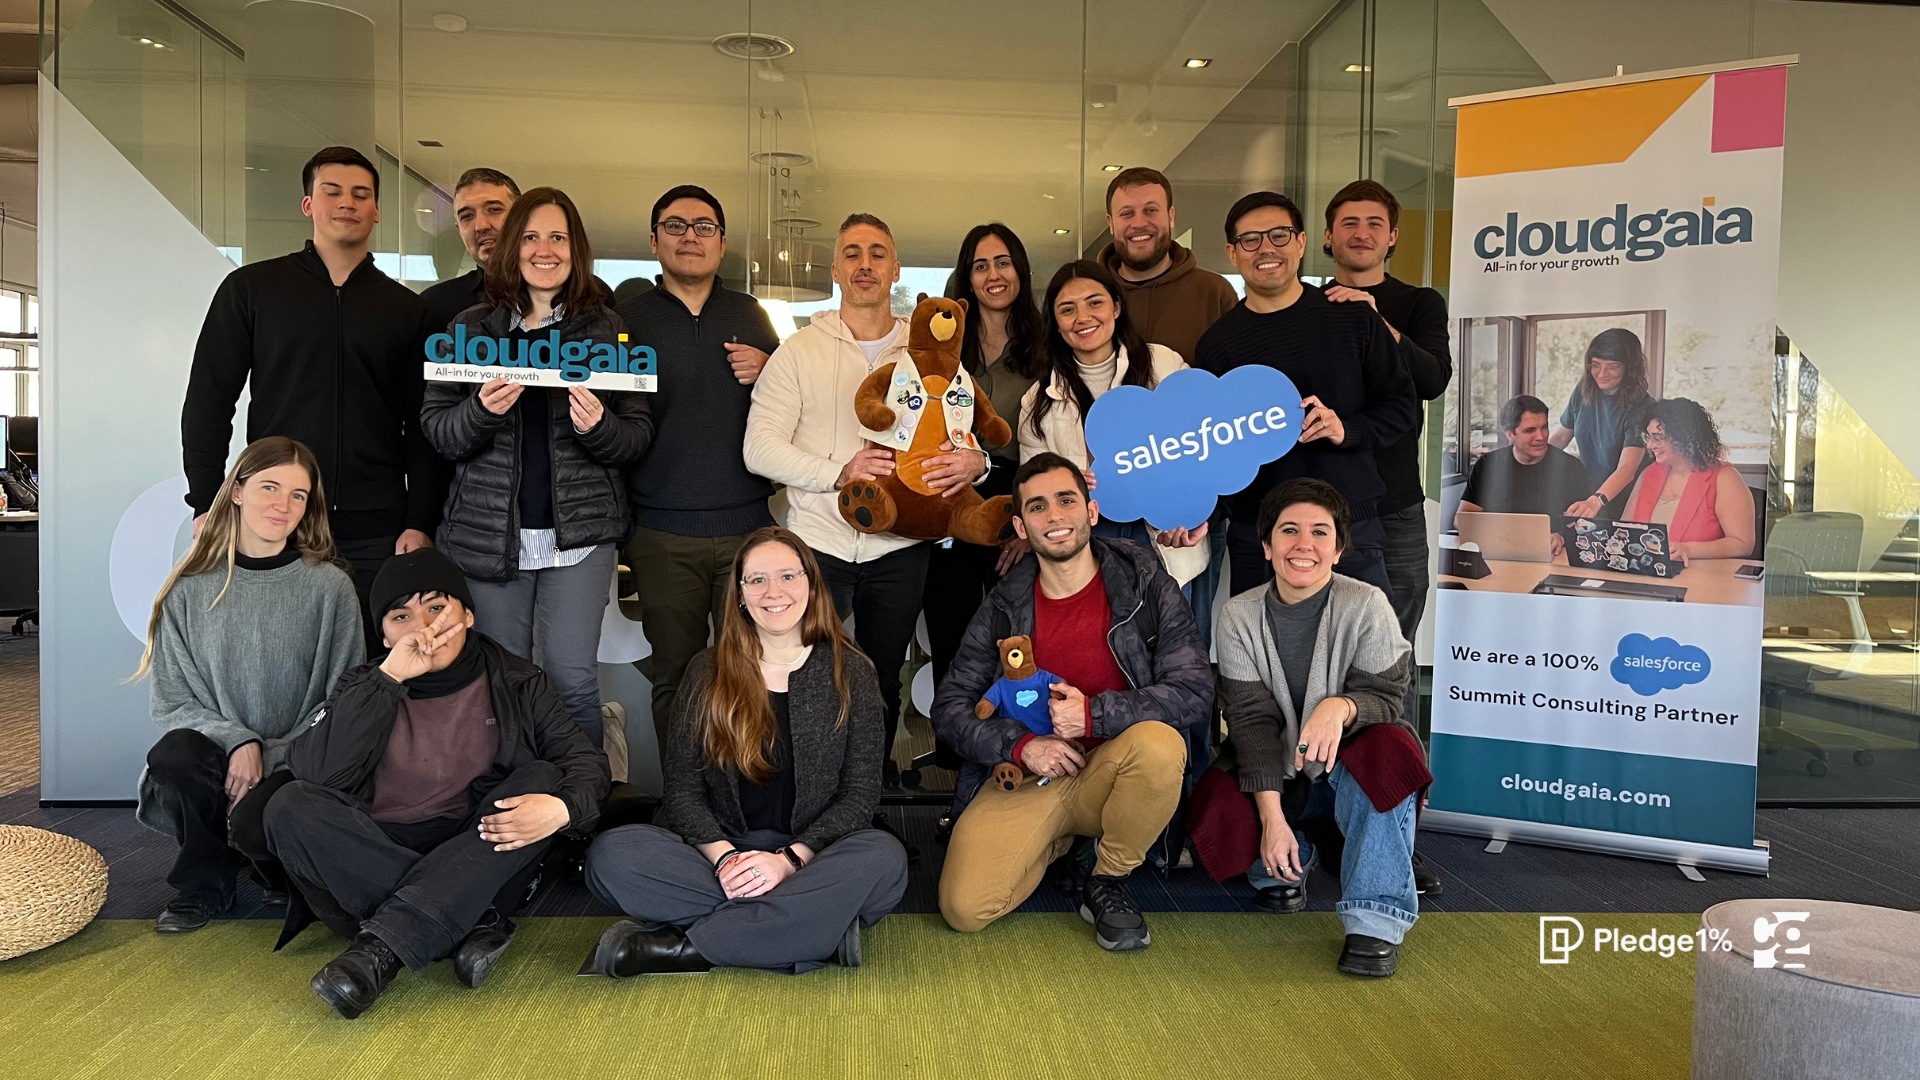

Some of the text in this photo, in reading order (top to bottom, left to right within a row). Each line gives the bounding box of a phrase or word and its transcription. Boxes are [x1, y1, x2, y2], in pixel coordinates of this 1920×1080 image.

[1474, 196, 1753, 262] cloudgaia
[1484, 255, 1619, 273] All-in for your growth
[424, 323, 658, 382] cloudgaia
[435, 367, 540, 381] All-in for your growth
[1114, 406, 1287, 474] salesforce
[1451, 645, 1599, 671] We are a 100%
[1623, 654, 1701, 673] salesforce
[1449, 685, 1739, 726] Summit Consulting Partner
[1501, 773, 1671, 808] cloudgaia.com
